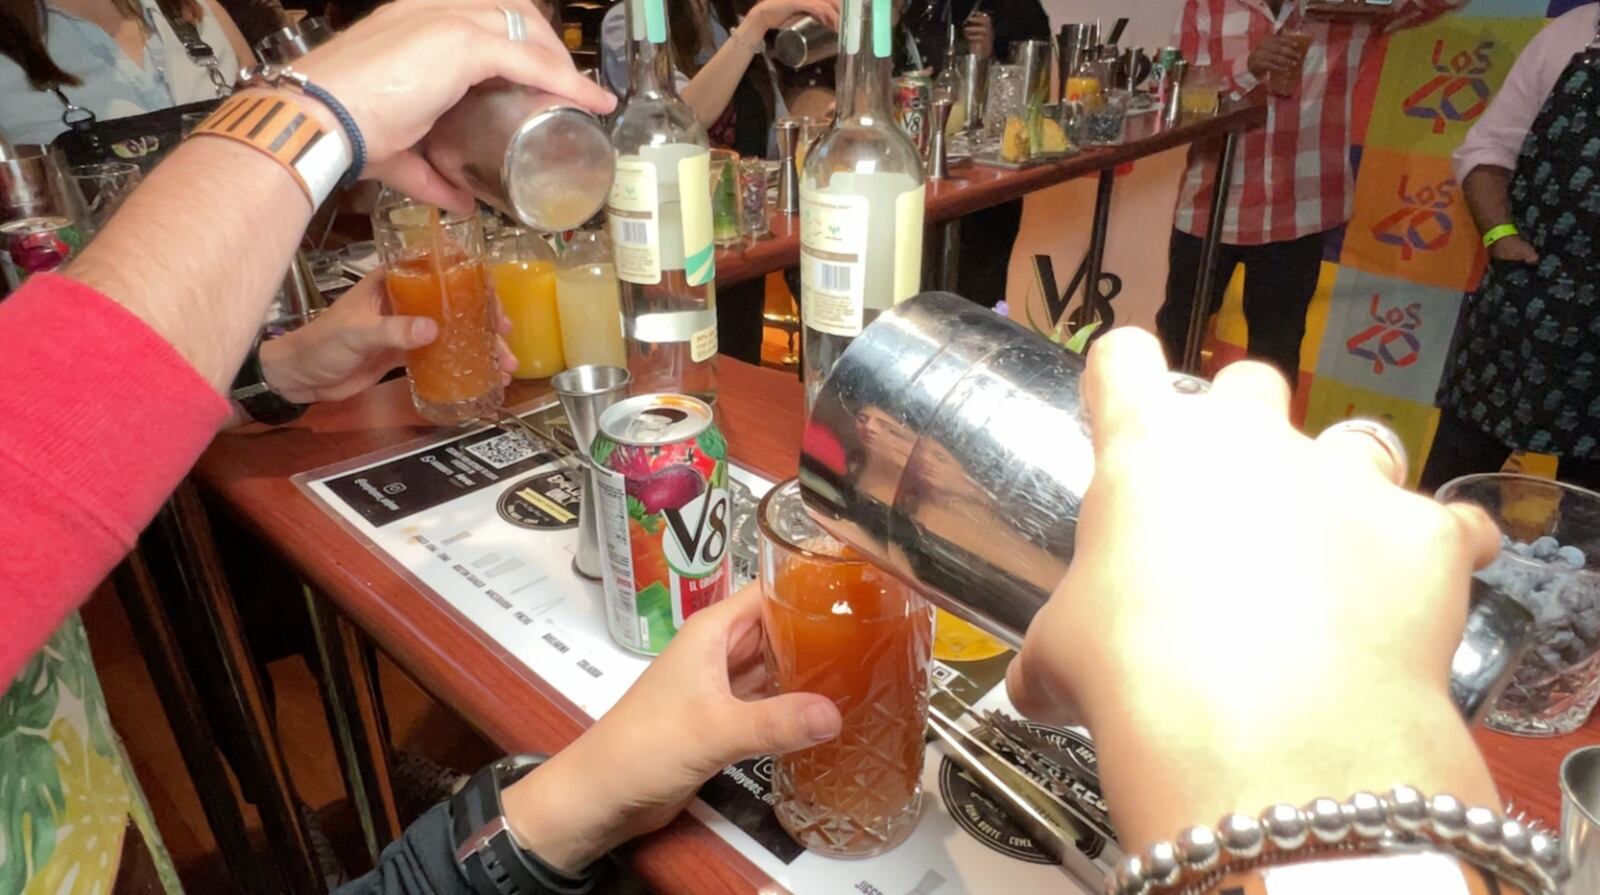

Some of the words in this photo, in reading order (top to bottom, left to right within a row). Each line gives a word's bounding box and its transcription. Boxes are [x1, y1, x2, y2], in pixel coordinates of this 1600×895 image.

[902, 112, 920, 133] V8
[1402, 74, 1490, 134] 40
[1371, 205, 1454, 261] 40
[1031, 253, 1122, 345] V8
[1345, 324, 1421, 375] 40
[661, 480, 727, 567] V8
